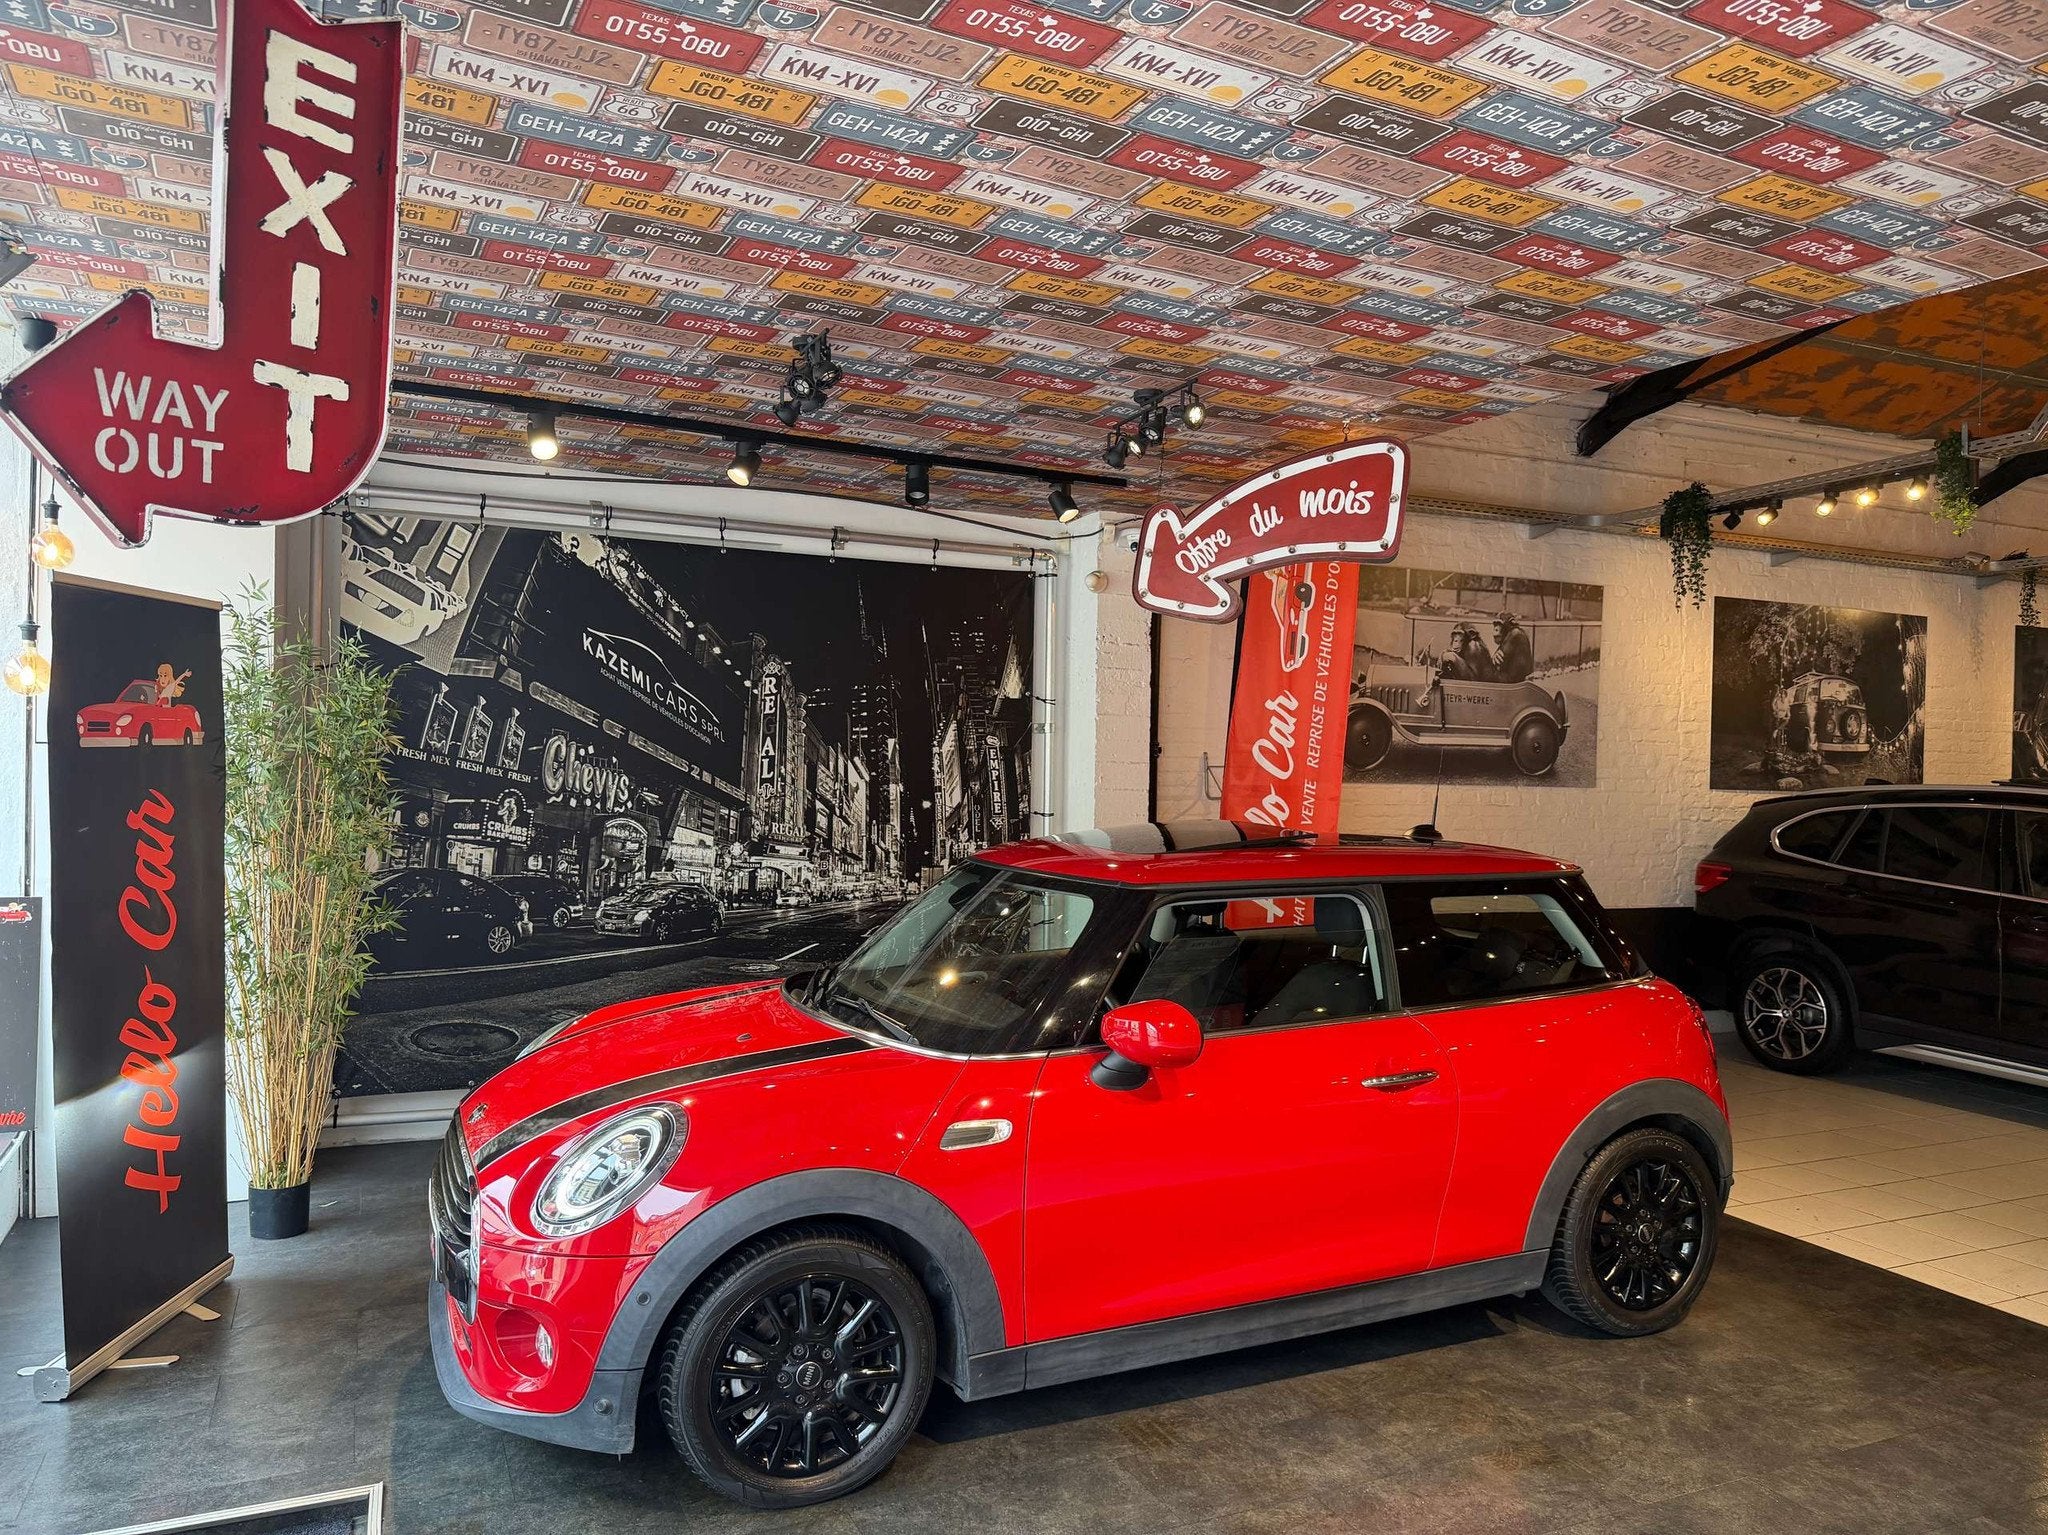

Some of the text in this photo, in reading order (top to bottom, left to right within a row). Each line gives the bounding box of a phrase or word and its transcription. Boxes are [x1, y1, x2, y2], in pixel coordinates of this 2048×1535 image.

[419, 10, 438, 24] 15
[775, 10, 798, 24] 15
[1005, 5, 1038, 18] TEXAS
[1142, 3, 1170, 18] 15
[1385, 0, 1418, 11] TEXAS
[71, 15, 95, 31] 15
[639, 12, 672, 24] TEXAS
[699, 72, 782, 95] NEW YORK
[1037, 66, 1116, 90] NEW YORK
[1387, 60, 1461, 84] NEW YORK
[620, 104, 641, 116] 66
[938, 100, 961, 112] 66
[1266, 97, 1292, 109] 66
[518, 114, 623, 146] GEH-142A
[827, 112, 930, 144] GEH-142A
[1146, 108, 1245, 141] GEH-142A
[866, 150, 893, 158] TEXAS
[977, 148, 998, 158] 15
[1282, 146, 1306, 156] 15
[478, 222, 567, 244] GEH-142A
[735, 220, 822, 243] GEH-142A
[999, 220, 1083, 243] GEH-142A
[252, 29, 358, 474] EXIT
[93, 367, 230, 432] WAY
[94, 426, 224, 484] OUT
[1175, 480, 1374, 574] Offre du mois
[1315, 594, 1337, 679] VÉHICULES
[583, 633, 725, 742] KAZEMI CARS SPRL
[1314, 682, 1327, 703] DE
[761, 676, 778, 780] REGAL
[1252, 690, 1298, 779] Car
[1306, 705, 1324, 769] REPRISE
[396, 747, 531, 783] FRESH MEX FRESH MEX FRESH
[989, 748, 1002, 813] EMPIRE
[1301, 779, 1317, 825] VENTE
[453, 822, 480, 830] CRUMBS
[487, 820, 527, 836] CRUMBS
[772, 822, 806, 837] REGAL
[117, 787, 183, 1214] Hello Car
